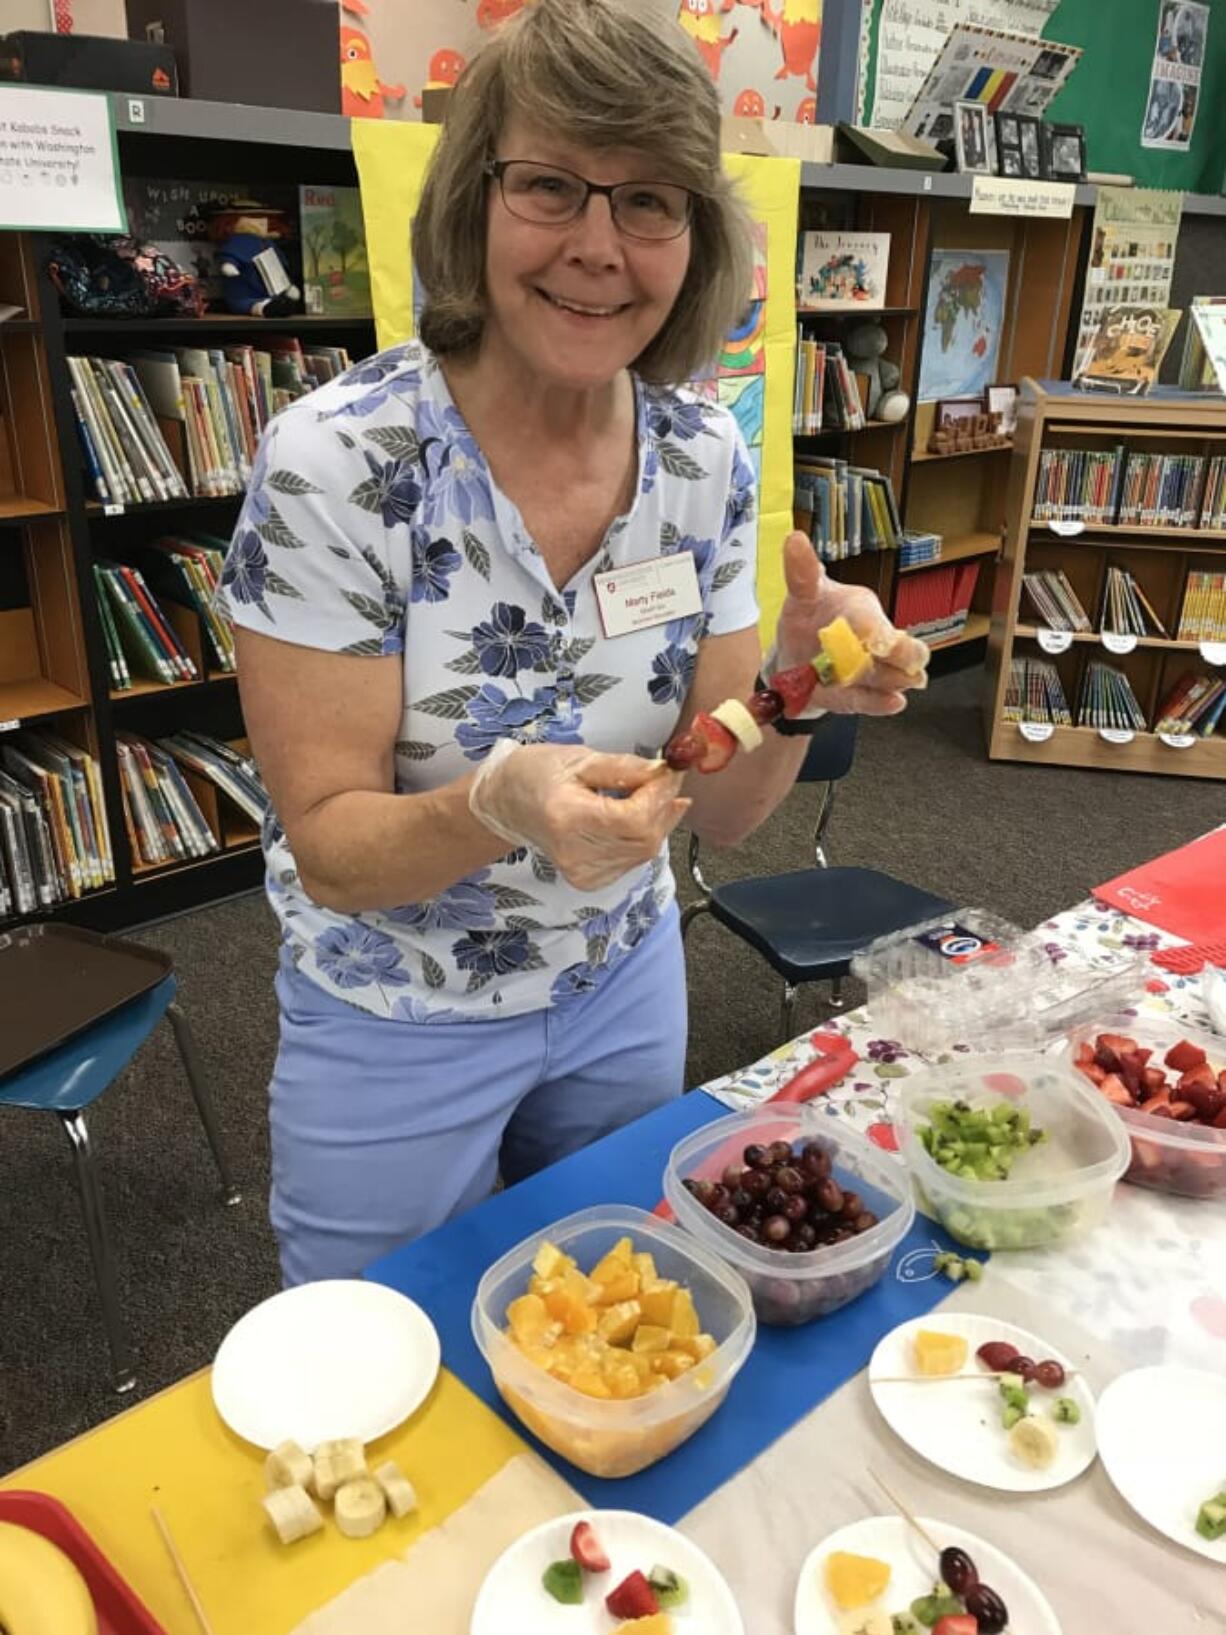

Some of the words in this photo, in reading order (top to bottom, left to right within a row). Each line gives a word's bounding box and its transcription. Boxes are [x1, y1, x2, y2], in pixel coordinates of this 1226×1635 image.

[51, 124, 81, 136] Snack
[10, 140, 32, 150] with
[36, 141, 97, 157] Washington
[146, 185, 190, 204] WISH
[190, 205, 200, 217] A
[814, 234, 829, 249] The
[837, 236, 879, 255] Journey
